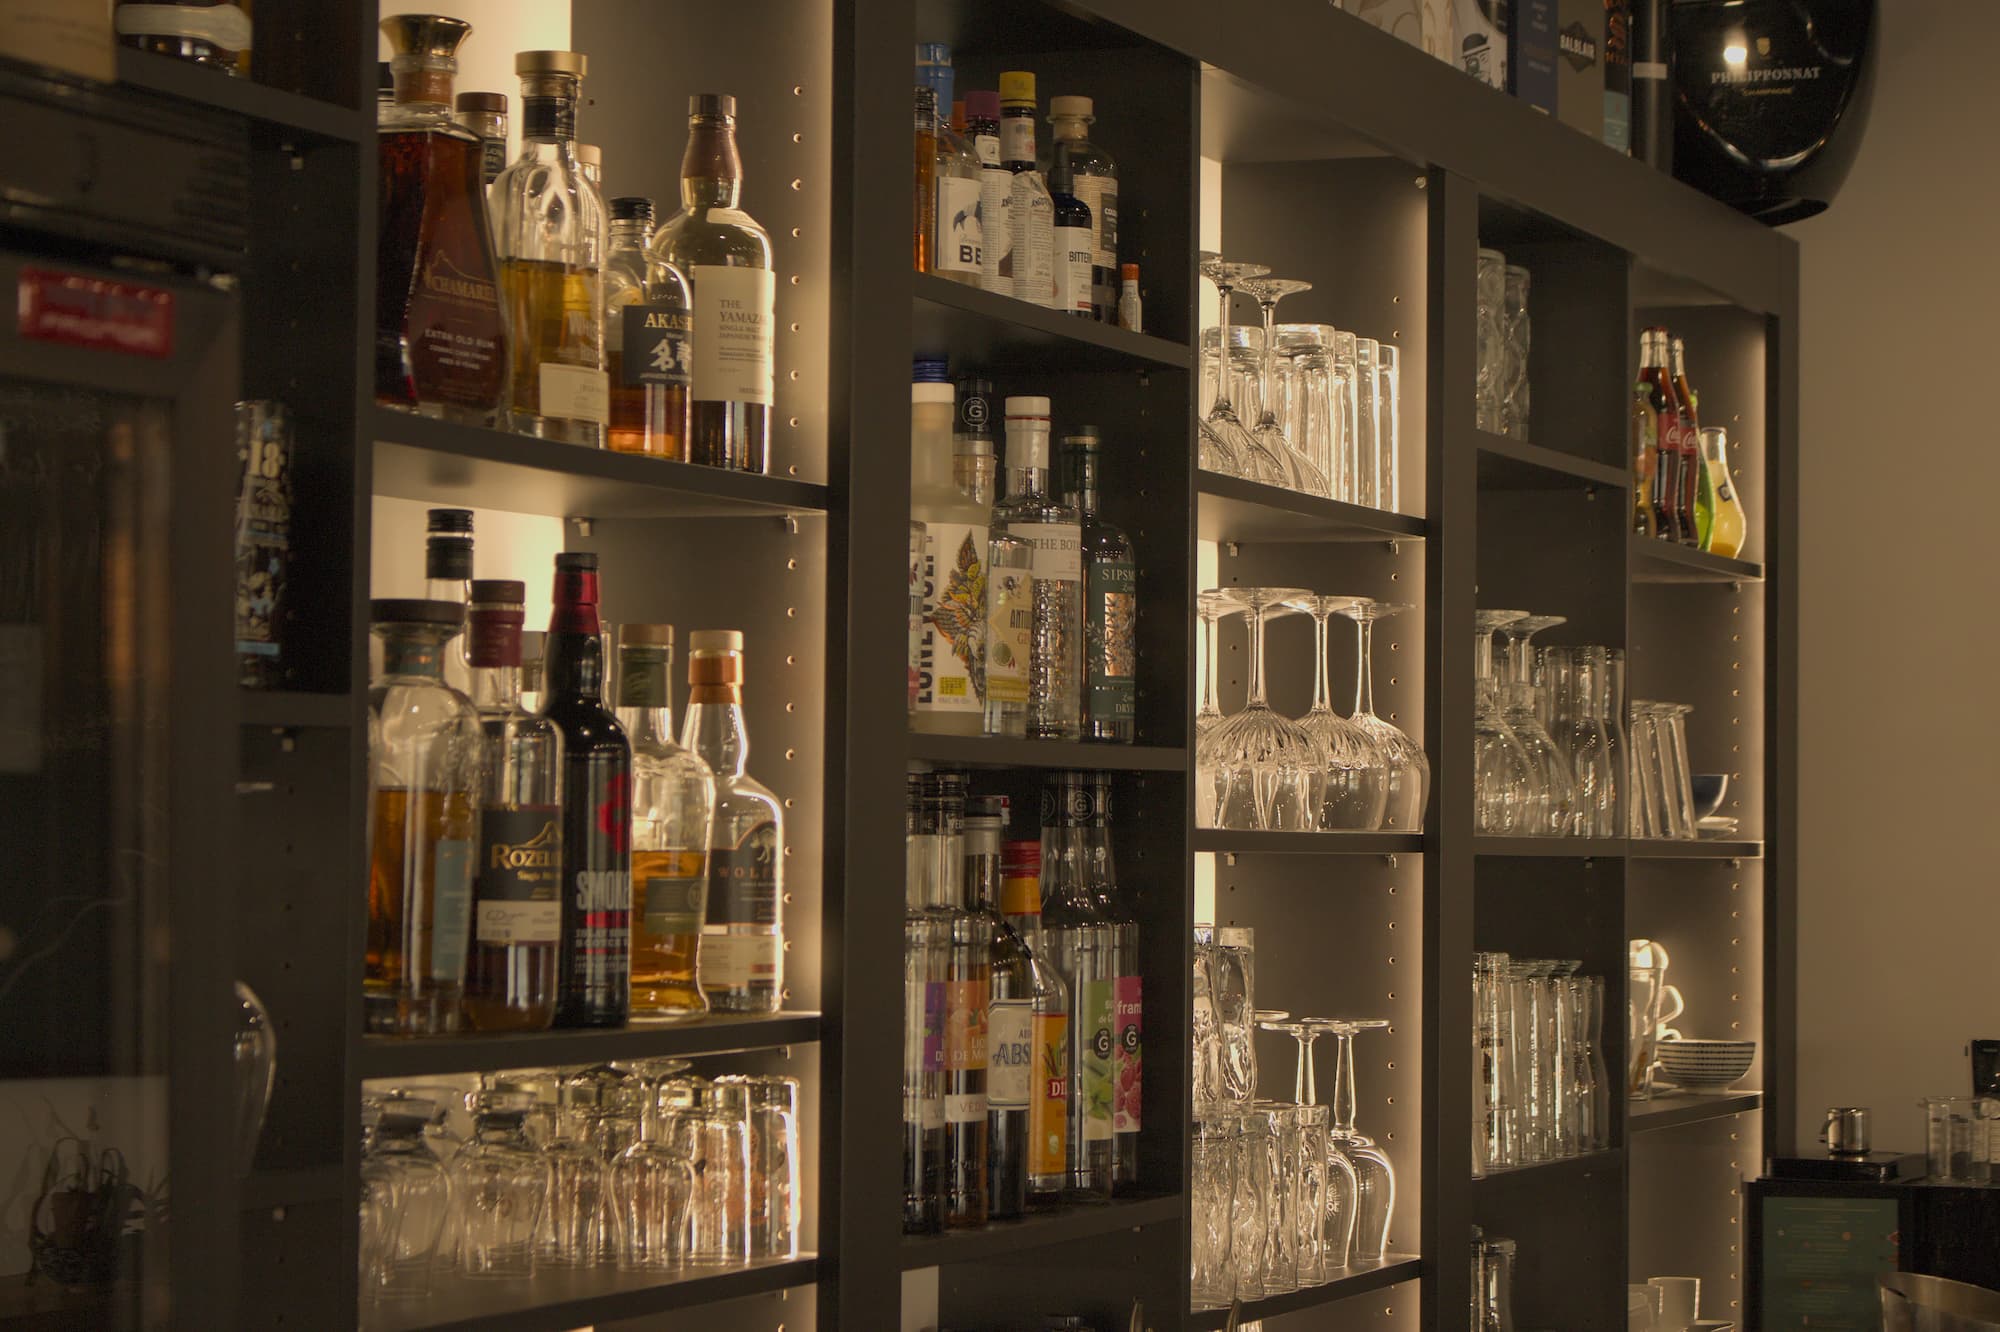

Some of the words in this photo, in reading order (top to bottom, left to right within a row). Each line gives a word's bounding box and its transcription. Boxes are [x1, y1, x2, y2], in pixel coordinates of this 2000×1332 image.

[720, 299, 744, 309] THE
[1032, 538, 1057, 550] THE
[1097, 1036, 1109, 1052] G
[1125, 1031, 1137, 1047] G
